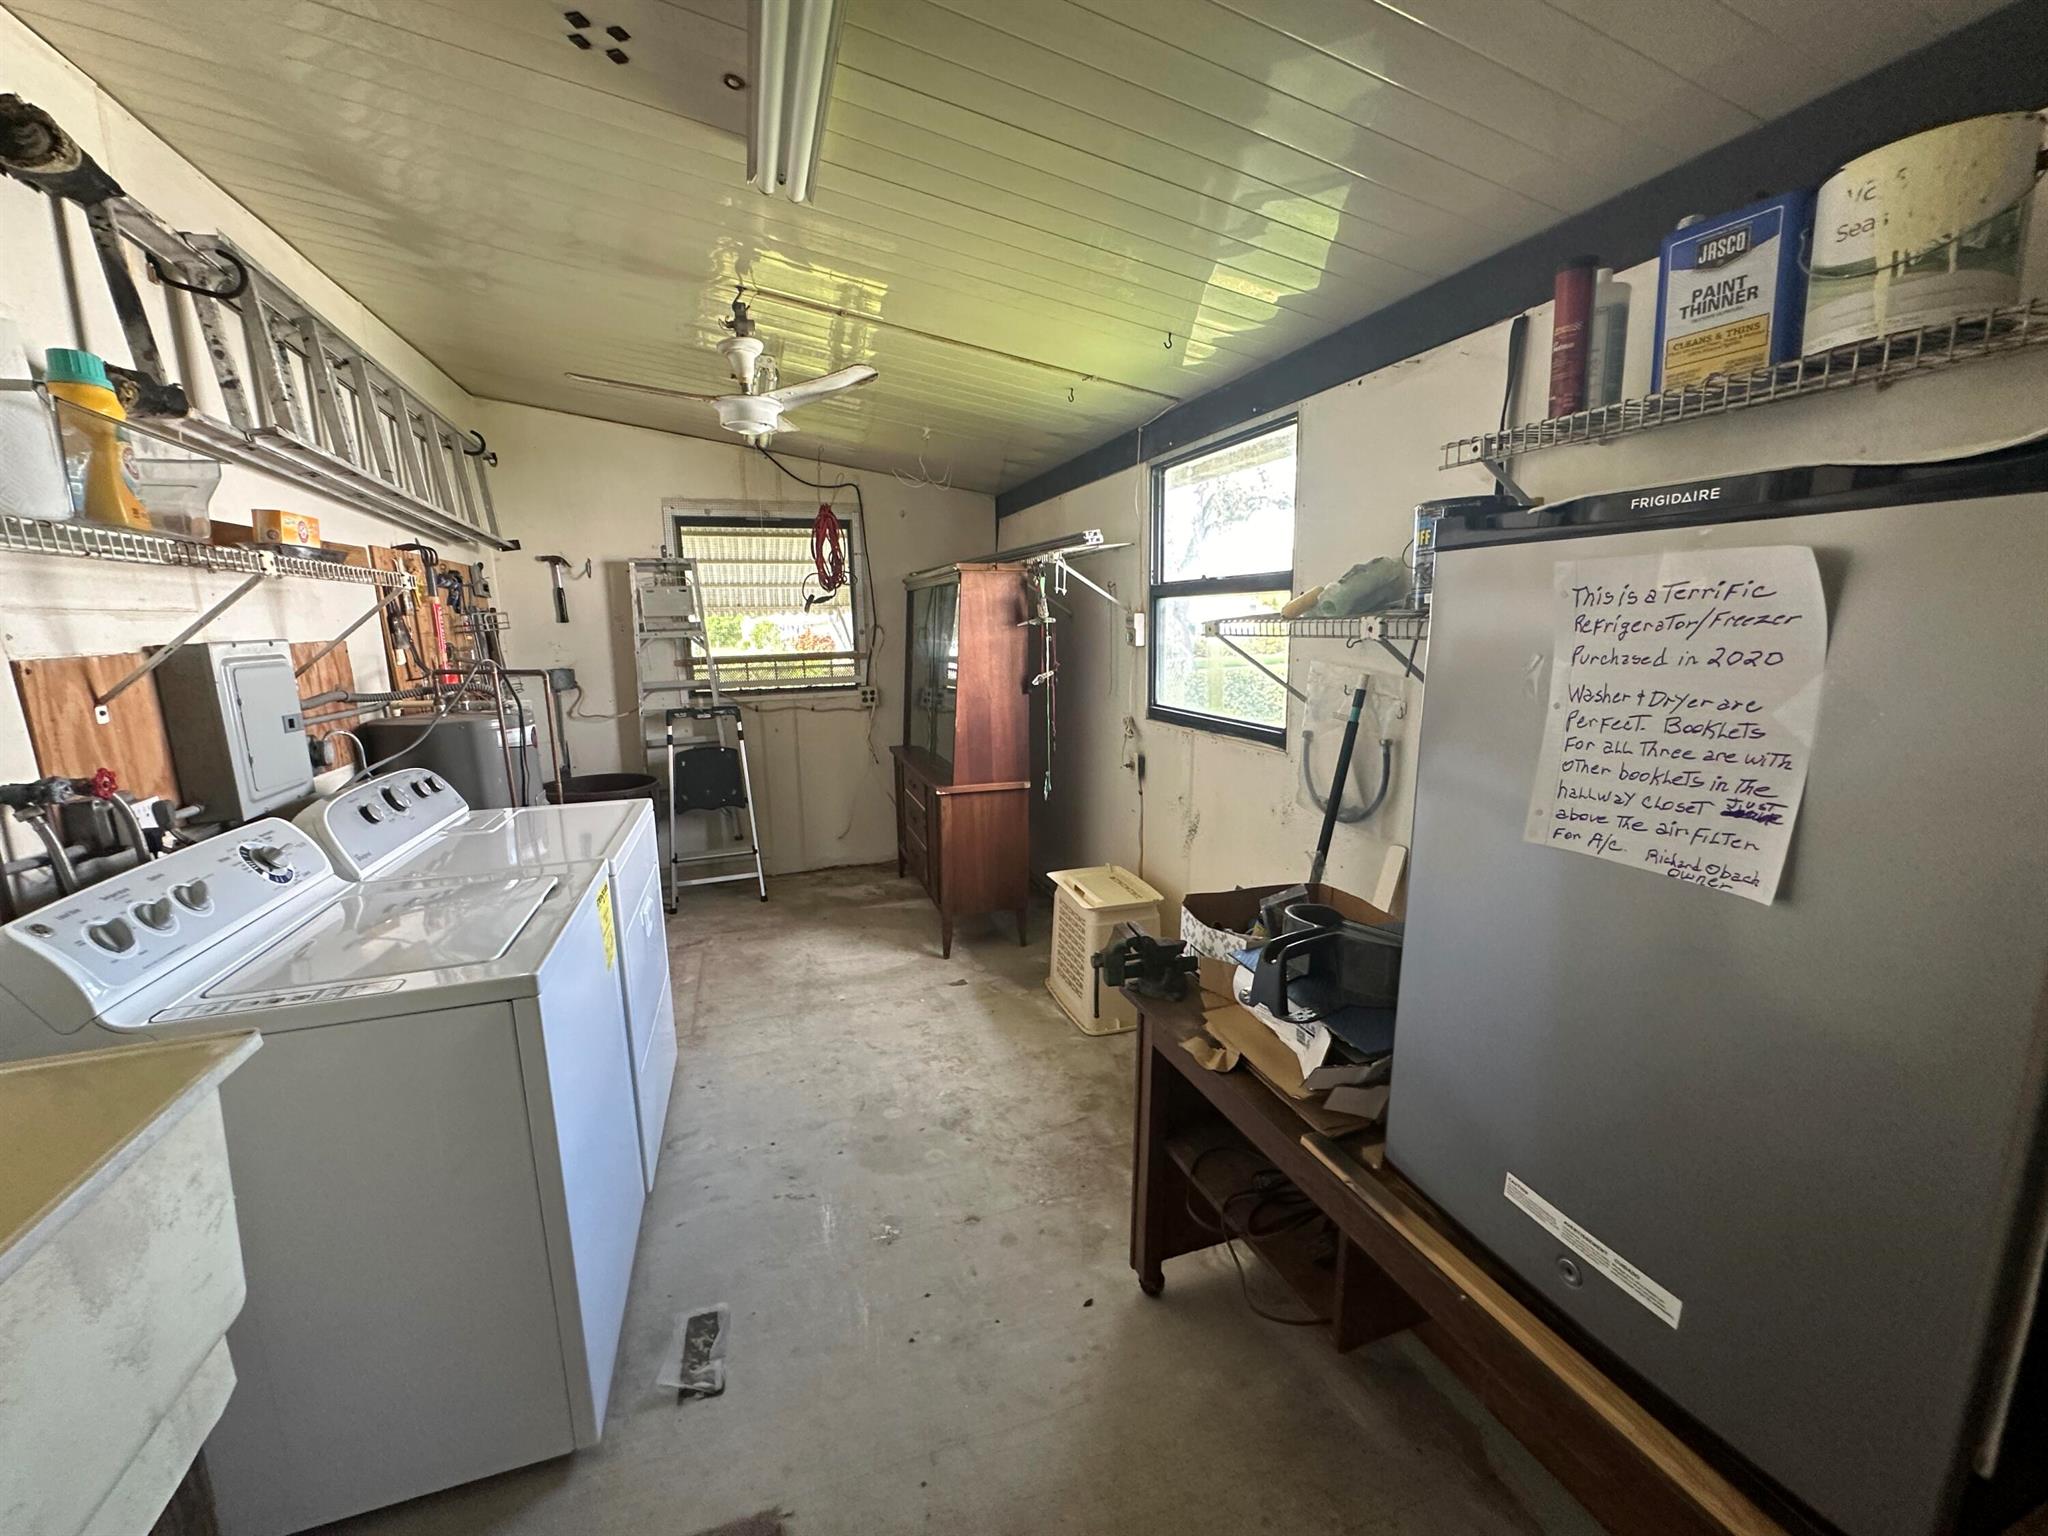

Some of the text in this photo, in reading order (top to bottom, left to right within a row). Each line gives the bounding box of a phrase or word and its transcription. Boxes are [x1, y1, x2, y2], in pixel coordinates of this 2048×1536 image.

[1698, 231, 1746, 264] JASCO
[1680, 285, 1759, 320] THINNER
[1692, 274, 1748, 304] PAINT
[1673, 334, 1713, 351] CLEANS
[1715, 331, 1722, 340] &
[1726, 321, 1761, 338] THINS
[1631, 487, 1720, 510] FRIGIDAIRE
[1572, 586, 1614, 608] This
[1618, 584, 1638, 607] is
[1644, 589, 1656, 604] a
[1571, 645, 1784, 668] Purchased in 2020
[1568, 683, 1631, 704] Washer
[1717, 699, 1763, 713] are
[1703, 750, 1739, 764] are
[1709, 776, 1729, 792] in
[1555, 807, 1609, 824] above
[1656, 821, 1689, 837] air
